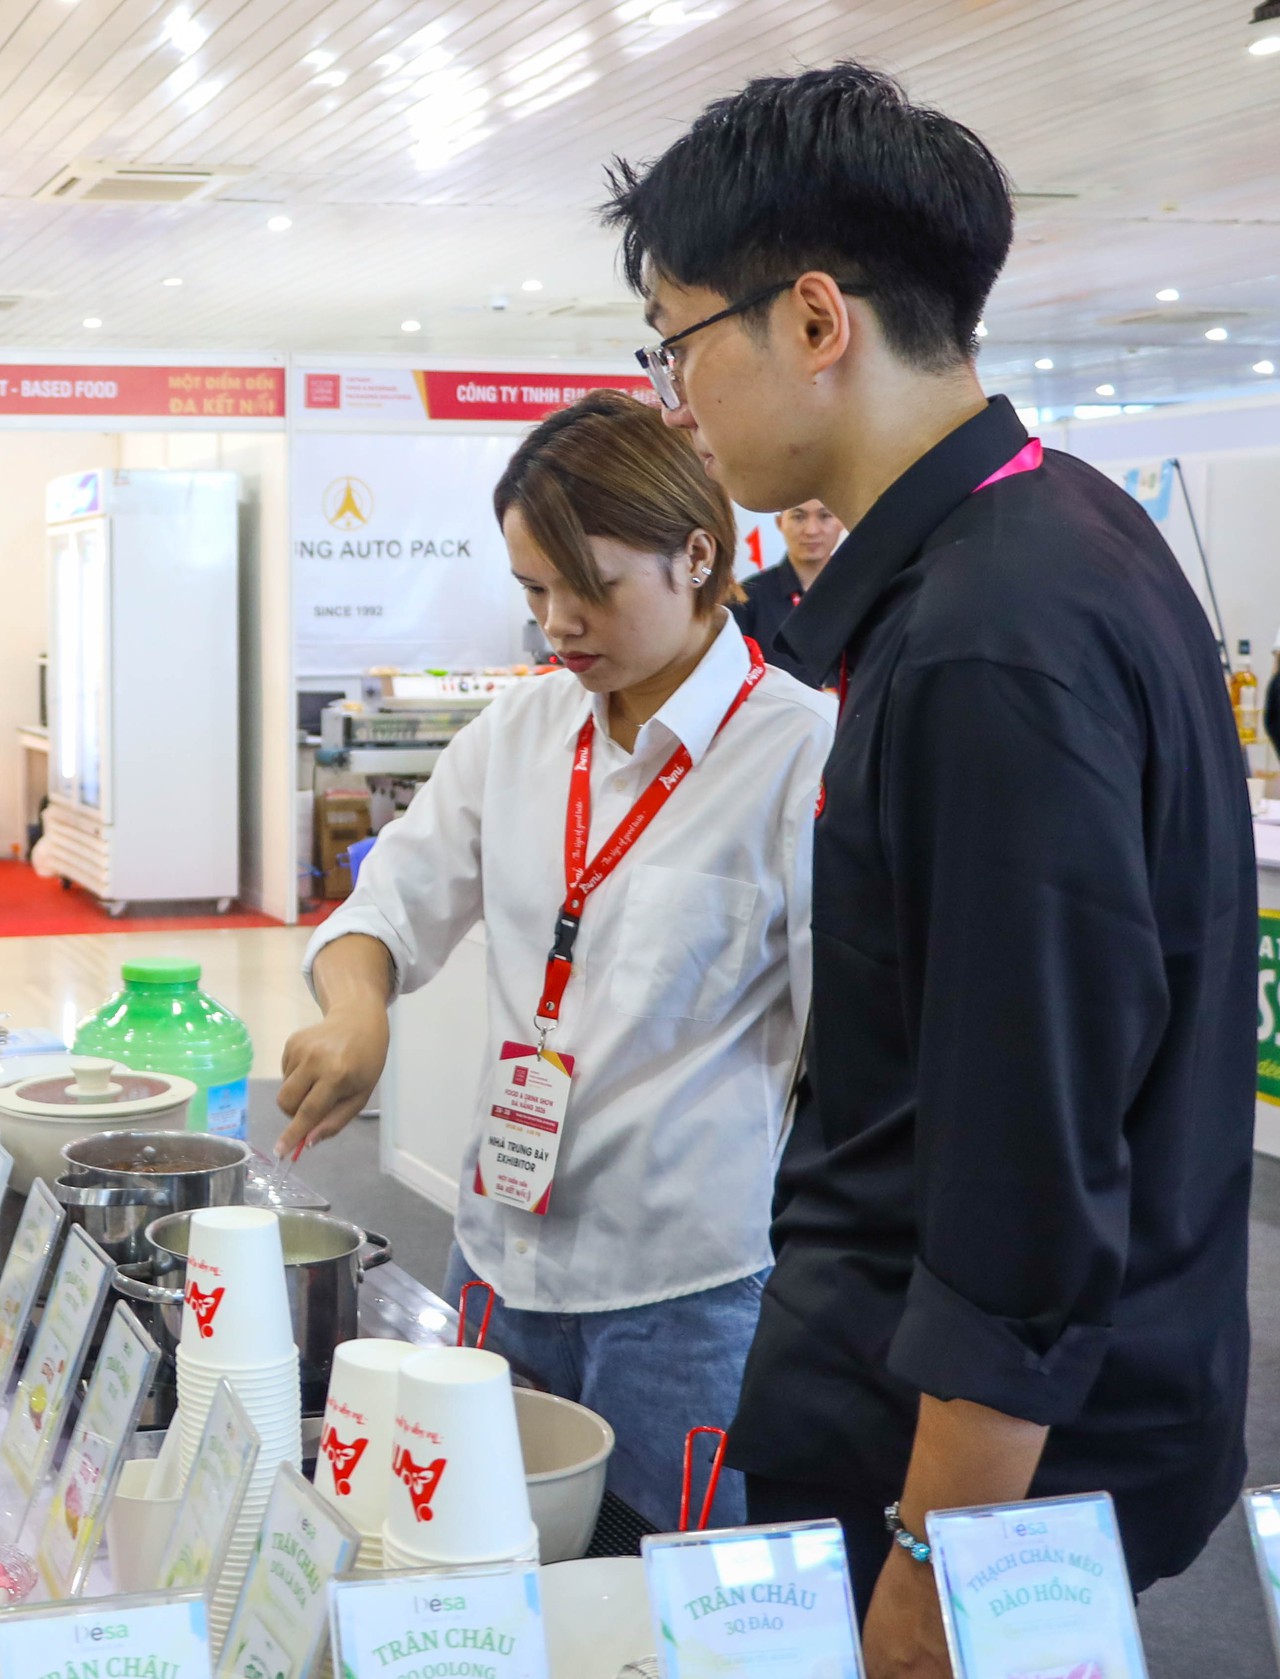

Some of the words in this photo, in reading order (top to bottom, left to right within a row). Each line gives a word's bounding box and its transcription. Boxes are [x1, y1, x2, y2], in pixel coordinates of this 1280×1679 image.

[21, 381, 71, 398] BASED
[75, 382, 118, 398] FOOD
[456, 382, 496, 402] CÔNG
[500, 386, 519, 403] TY
[522, 387, 560, 404] TNHH
[295, 540, 332, 559] NG
[341, 540, 402, 558] AUTO
[411, 540, 471, 558] PACK
[313, 606, 352, 617] SINCE
[357, 606, 383, 617] 1992
[488, 1135, 505, 1149] NHÀ
[533, 1145, 549, 1163] BÀY
[496, 1152, 536, 1173] EXHIBITOR
[684, 1585, 746, 1621] TRÂN
[751, 1583, 817, 1610] CHÂU
[372, 1630, 440, 1666] TRÂN
[445, 1626, 517, 1656] CHÂU
